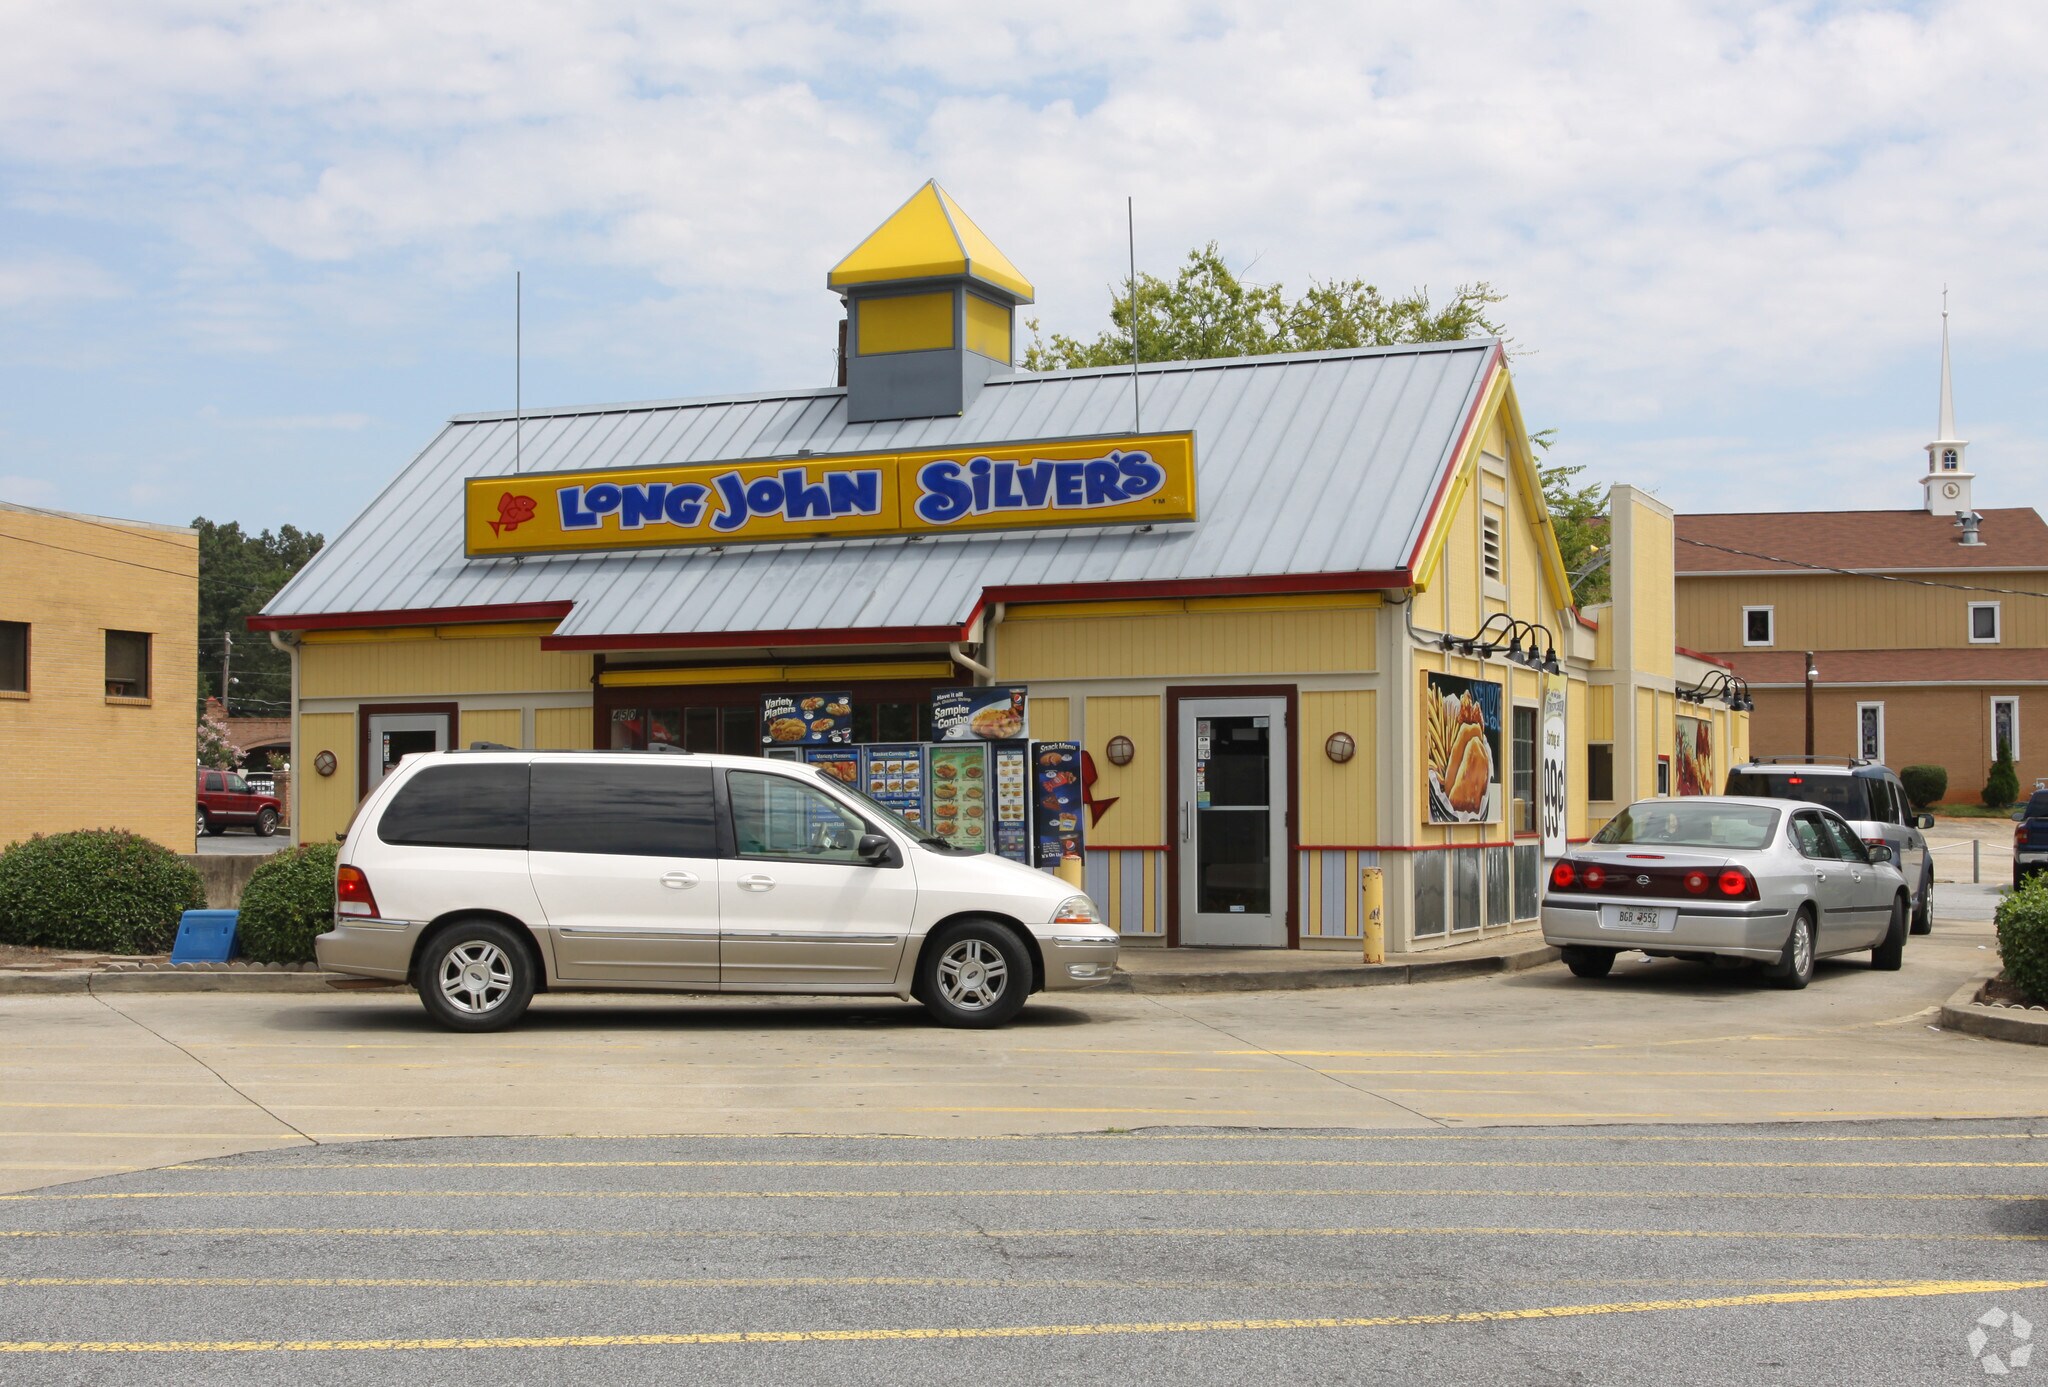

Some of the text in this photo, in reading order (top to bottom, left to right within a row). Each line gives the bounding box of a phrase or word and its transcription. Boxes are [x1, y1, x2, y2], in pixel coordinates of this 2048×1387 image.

[765, 697, 794, 710] Variety
[936, 693, 951, 701] Have
[613, 710, 635, 720] 450
[764, 706, 796, 721] Platters
[934, 704, 970, 720] Sampler
[937, 714, 969, 729] Combo
[1040, 742, 1076, 753] Snack Menu
[1545, 758, 1563, 838] 99¢
